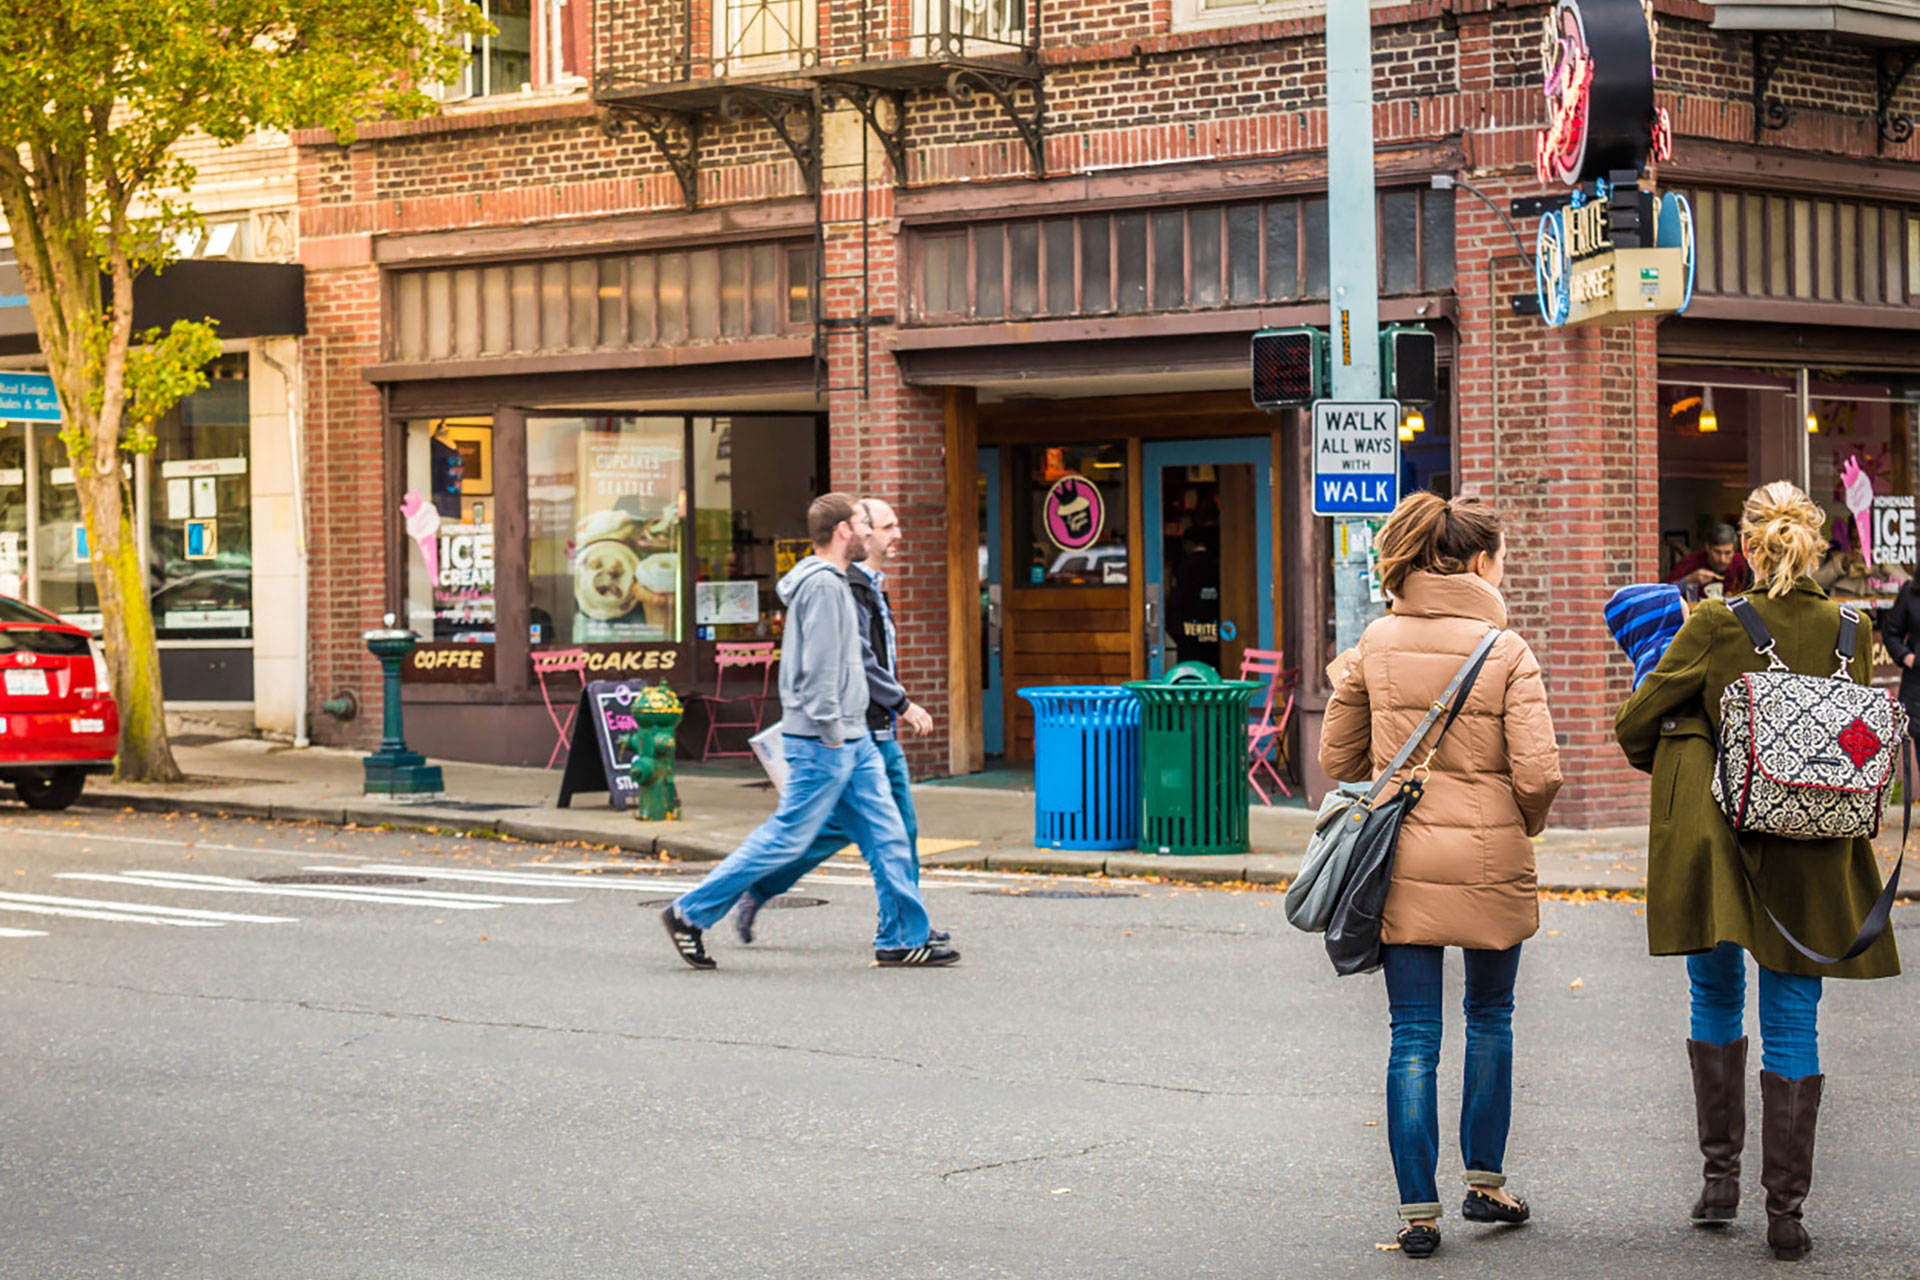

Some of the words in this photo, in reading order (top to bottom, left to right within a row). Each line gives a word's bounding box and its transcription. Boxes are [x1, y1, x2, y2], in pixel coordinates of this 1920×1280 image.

[1325, 411, 1387, 431] WALK
[1321, 438, 1349, 454] ALL
[1355, 438, 1392, 454] WAYS
[595, 453, 660, 471] CUPCAKES
[1342, 459, 1371, 471] WITH
[598, 479, 655, 497] SEATTLE
[1323, 481, 1389, 503] WALK
[1873, 509, 1916, 546] ICE
[441, 534, 495, 569] ICE
[1872, 545, 1917, 565] CREAM
[414, 649, 484, 669] COFFEE
